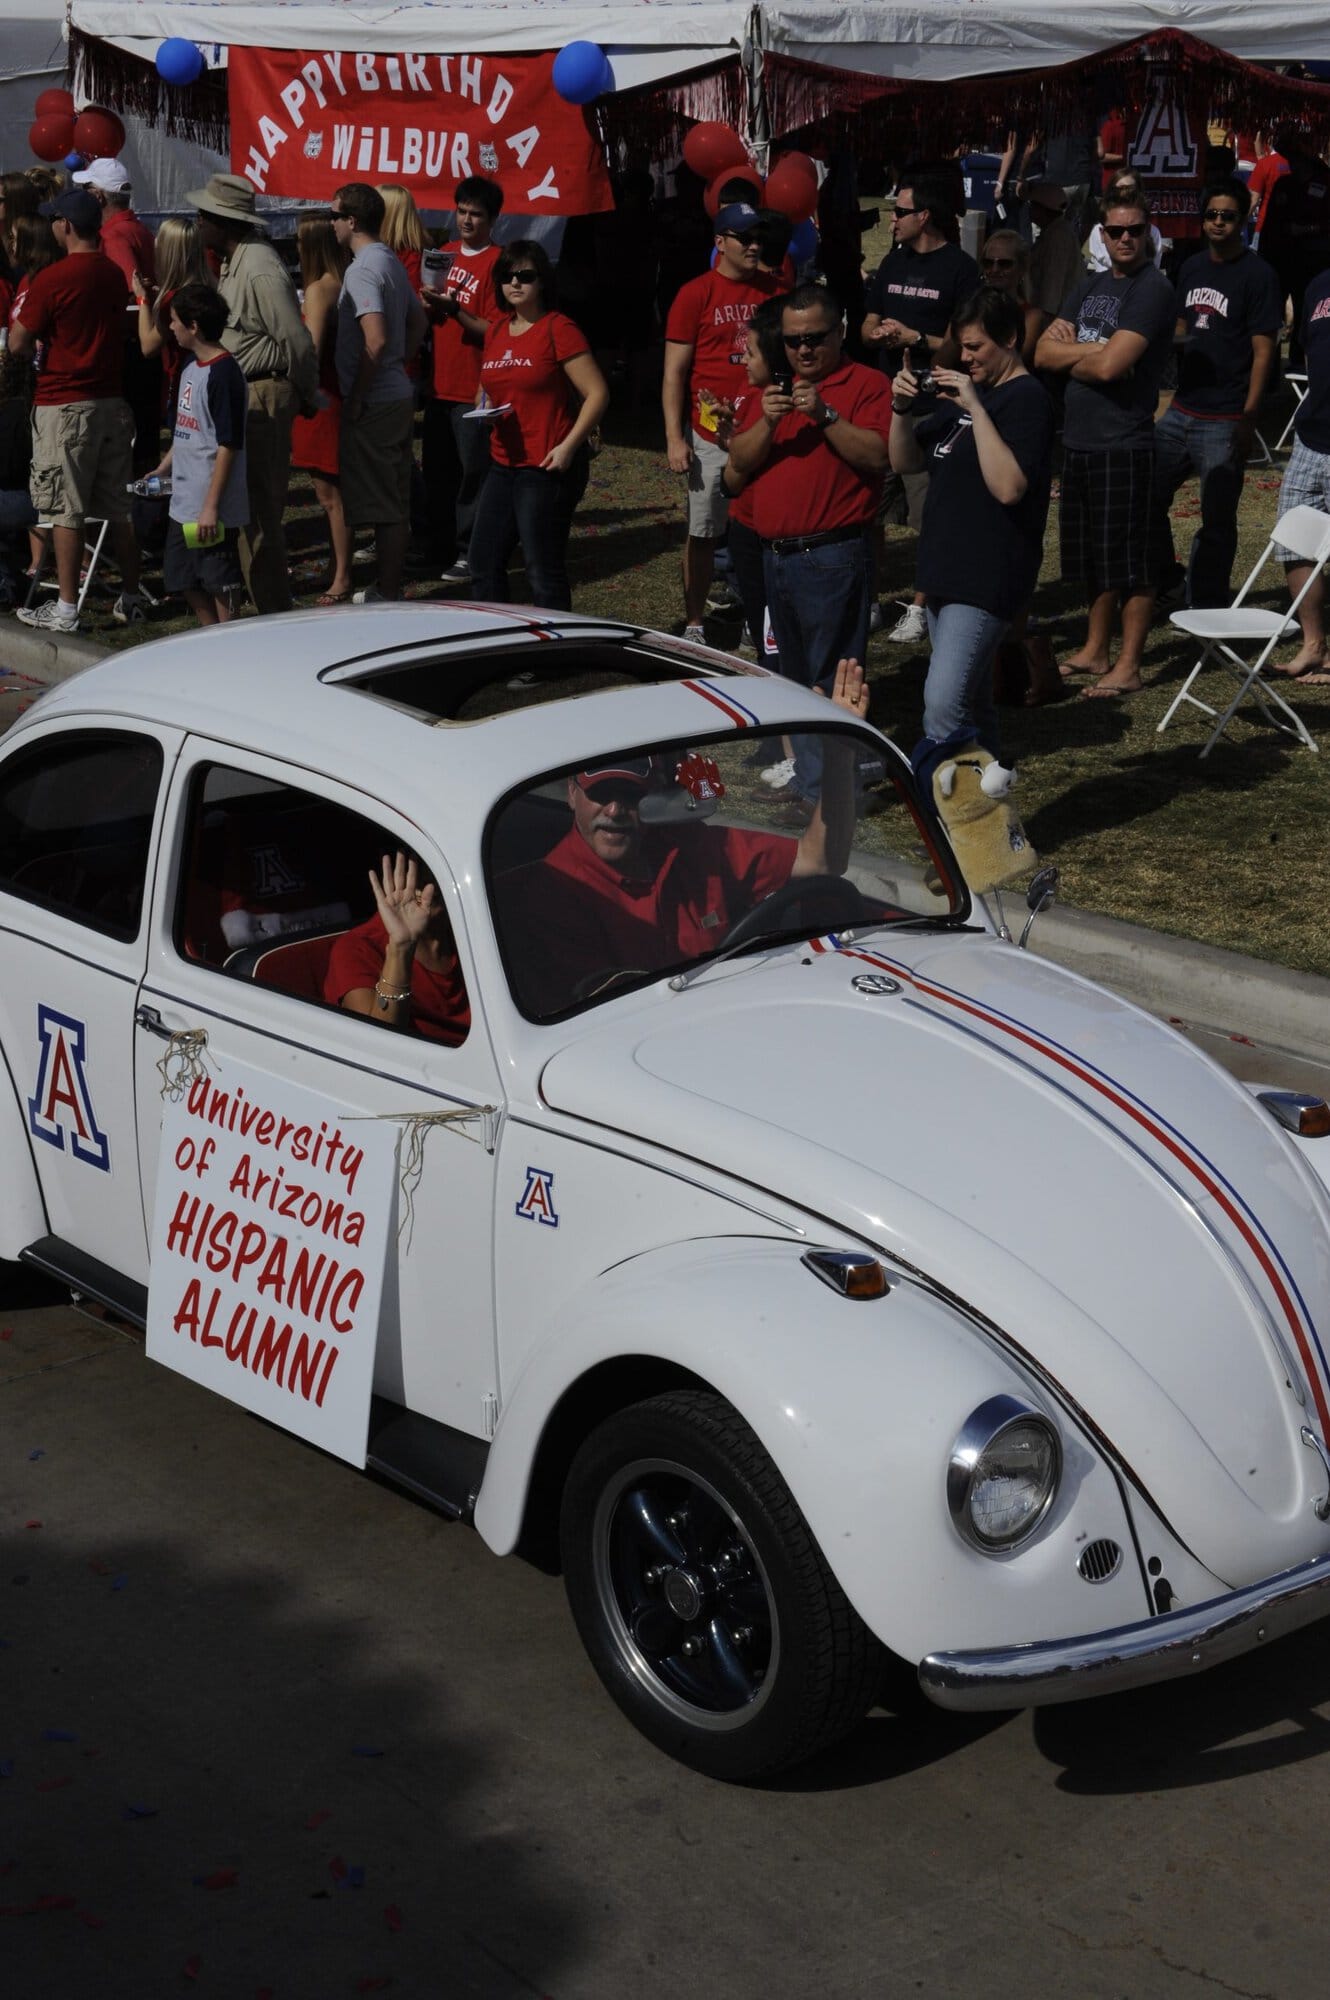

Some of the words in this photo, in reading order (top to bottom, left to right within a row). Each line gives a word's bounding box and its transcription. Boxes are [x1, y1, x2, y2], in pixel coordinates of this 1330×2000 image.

[245, 51, 346, 192] HAPPY
[1185, 286, 1229, 318] ARIZONA
[482, 358, 533, 369] ARIZONA
[697, 779, 717, 798] A
[28, 1003, 110, 1173] A
[187, 1077, 364, 1196] University
[175, 1137, 216, 1178] of
[229, 1154, 365, 1248] Arizona
[516, 1166, 559, 1227] A
[167, 1191, 365, 1333] HISPANIC
[173, 1279, 339, 1408] ALUMNI
